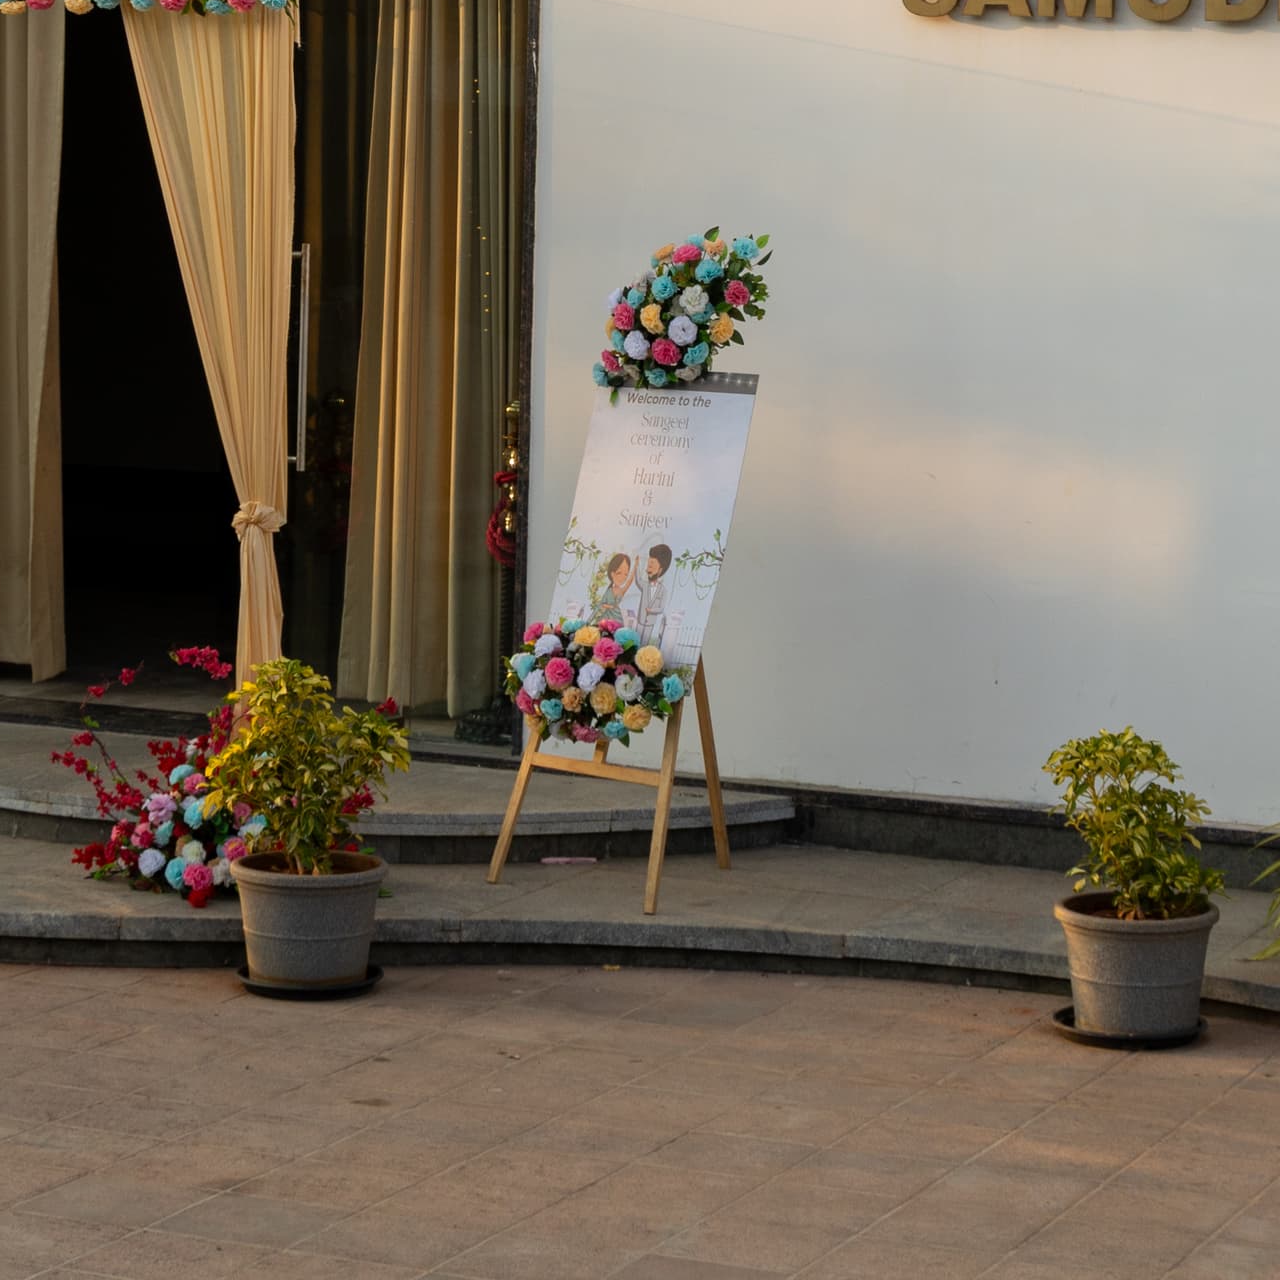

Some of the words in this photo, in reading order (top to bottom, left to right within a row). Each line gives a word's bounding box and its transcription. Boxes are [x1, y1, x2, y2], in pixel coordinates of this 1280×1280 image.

[627, 392, 677, 406] Welcome
[678, 396, 690, 407] to
[692, 395, 712, 408] the
[630, 433, 694, 454] ceremony
[648, 450, 664, 465] of
